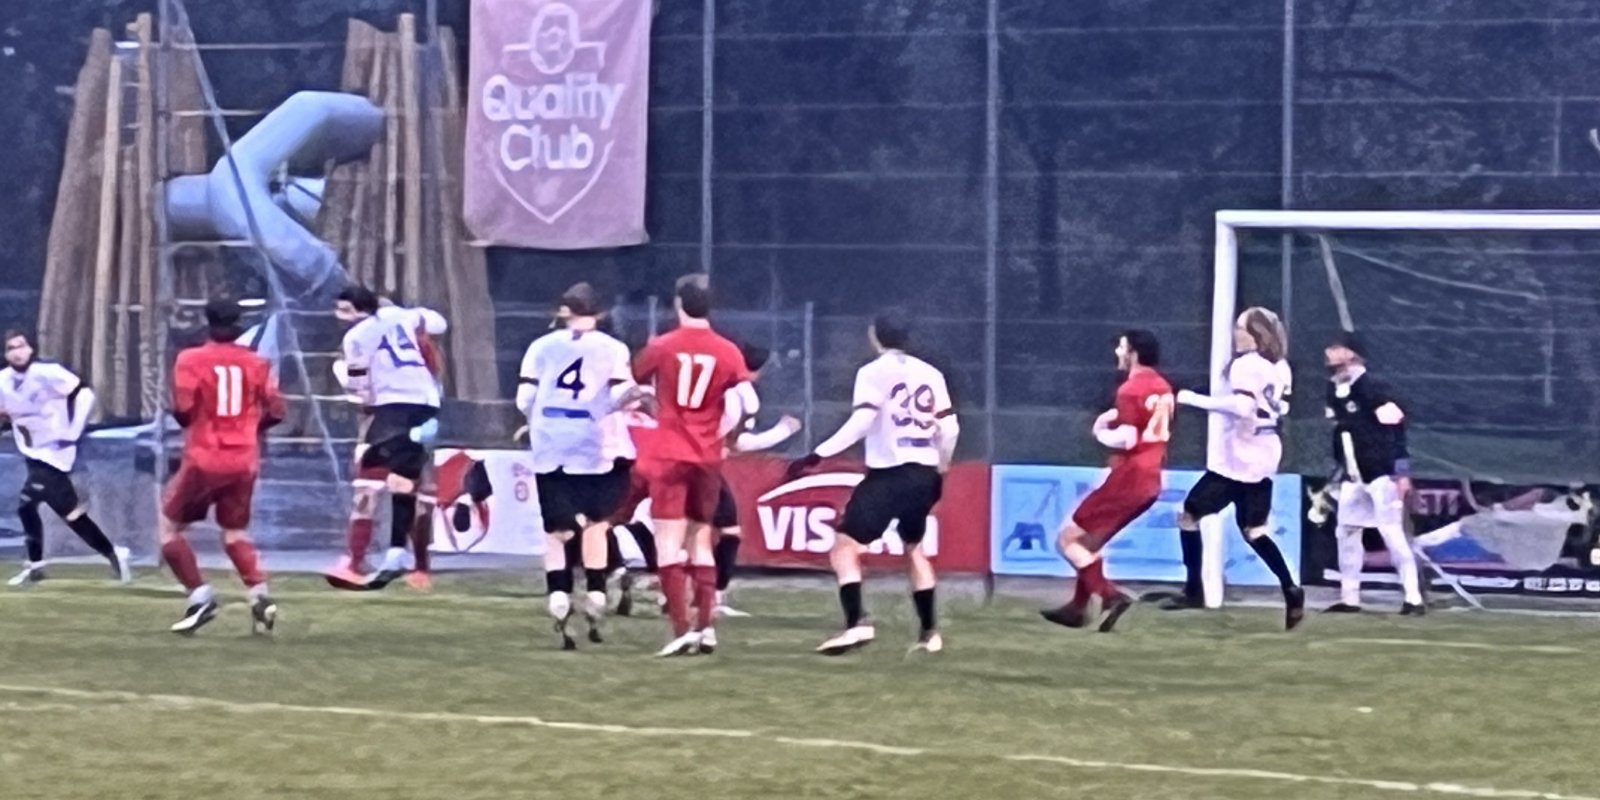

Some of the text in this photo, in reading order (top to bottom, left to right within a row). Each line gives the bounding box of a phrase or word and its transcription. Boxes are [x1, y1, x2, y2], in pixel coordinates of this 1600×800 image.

[482, 72, 625, 130] Quality
[500, 123, 594, 171] Club
[213, 364, 243, 416] 11
[556, 356, 586, 400] 4
[676, 352, 716, 409] 17
